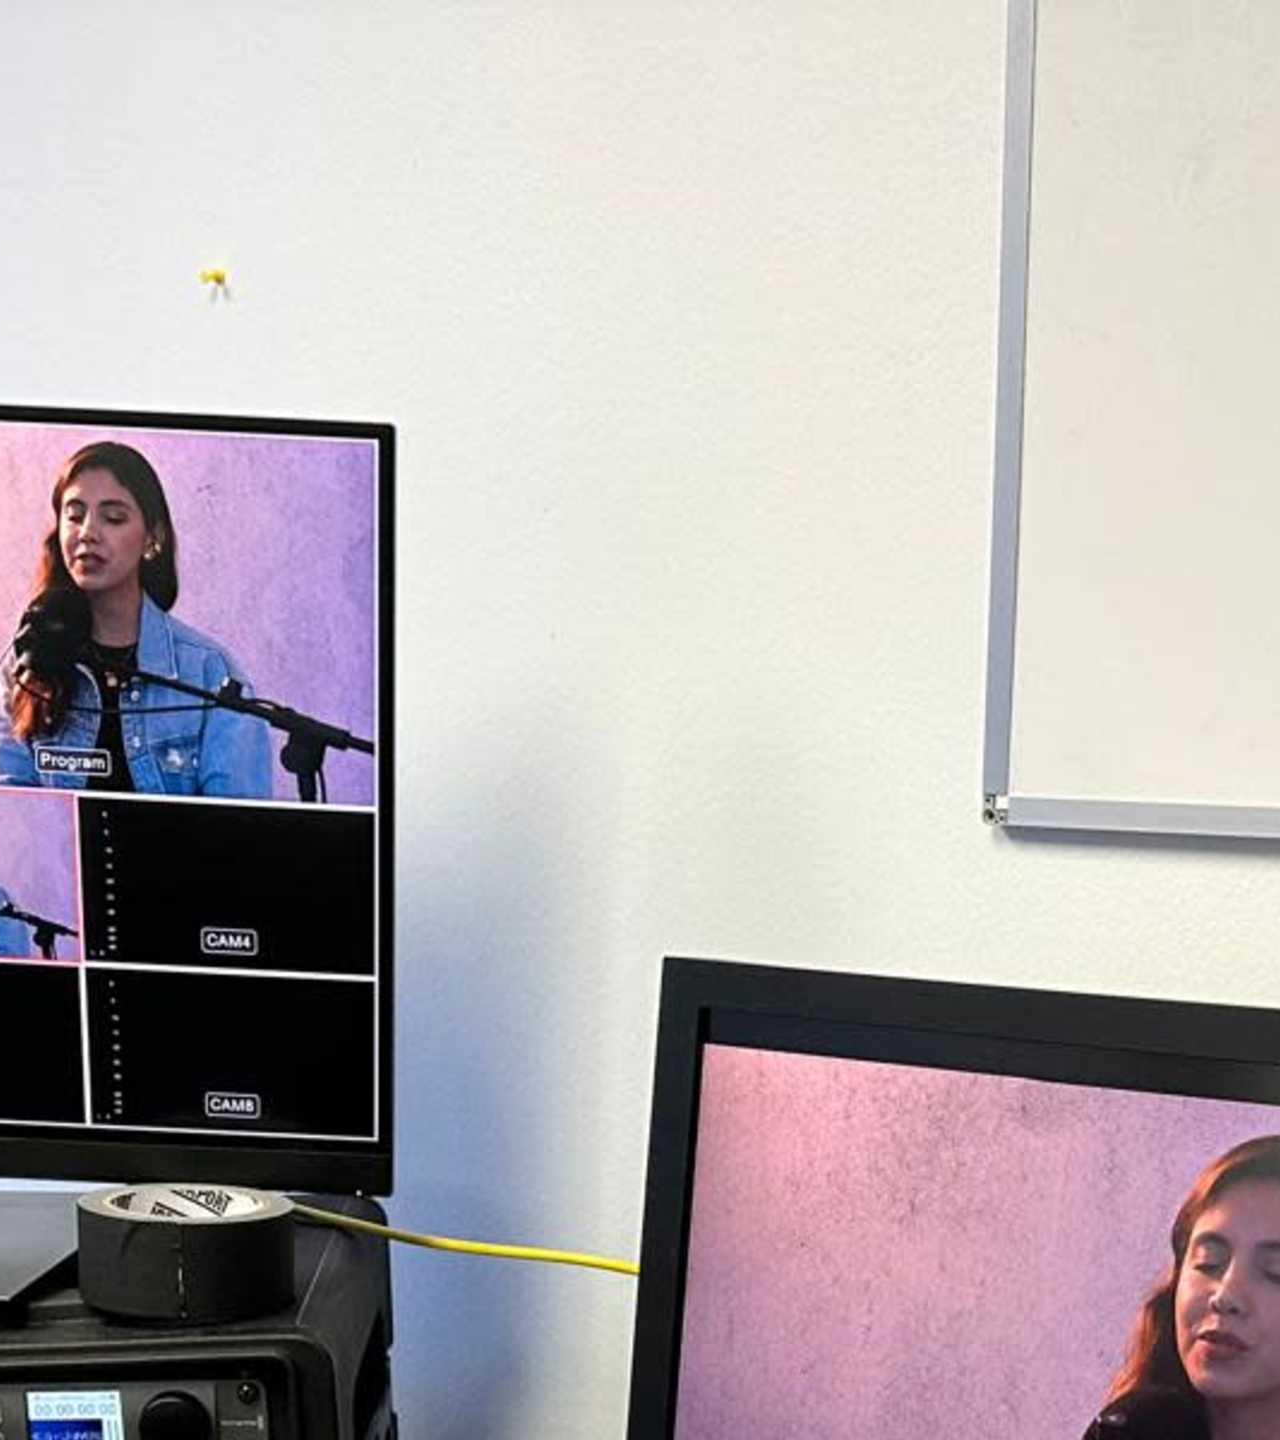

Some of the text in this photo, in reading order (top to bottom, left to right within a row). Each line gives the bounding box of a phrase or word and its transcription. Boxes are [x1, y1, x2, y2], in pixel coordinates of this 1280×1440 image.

[40, 752, 106, 772] Program
[207, 933, 253, 950] CAM4
[210, 1096, 256, 1114] CAM8
